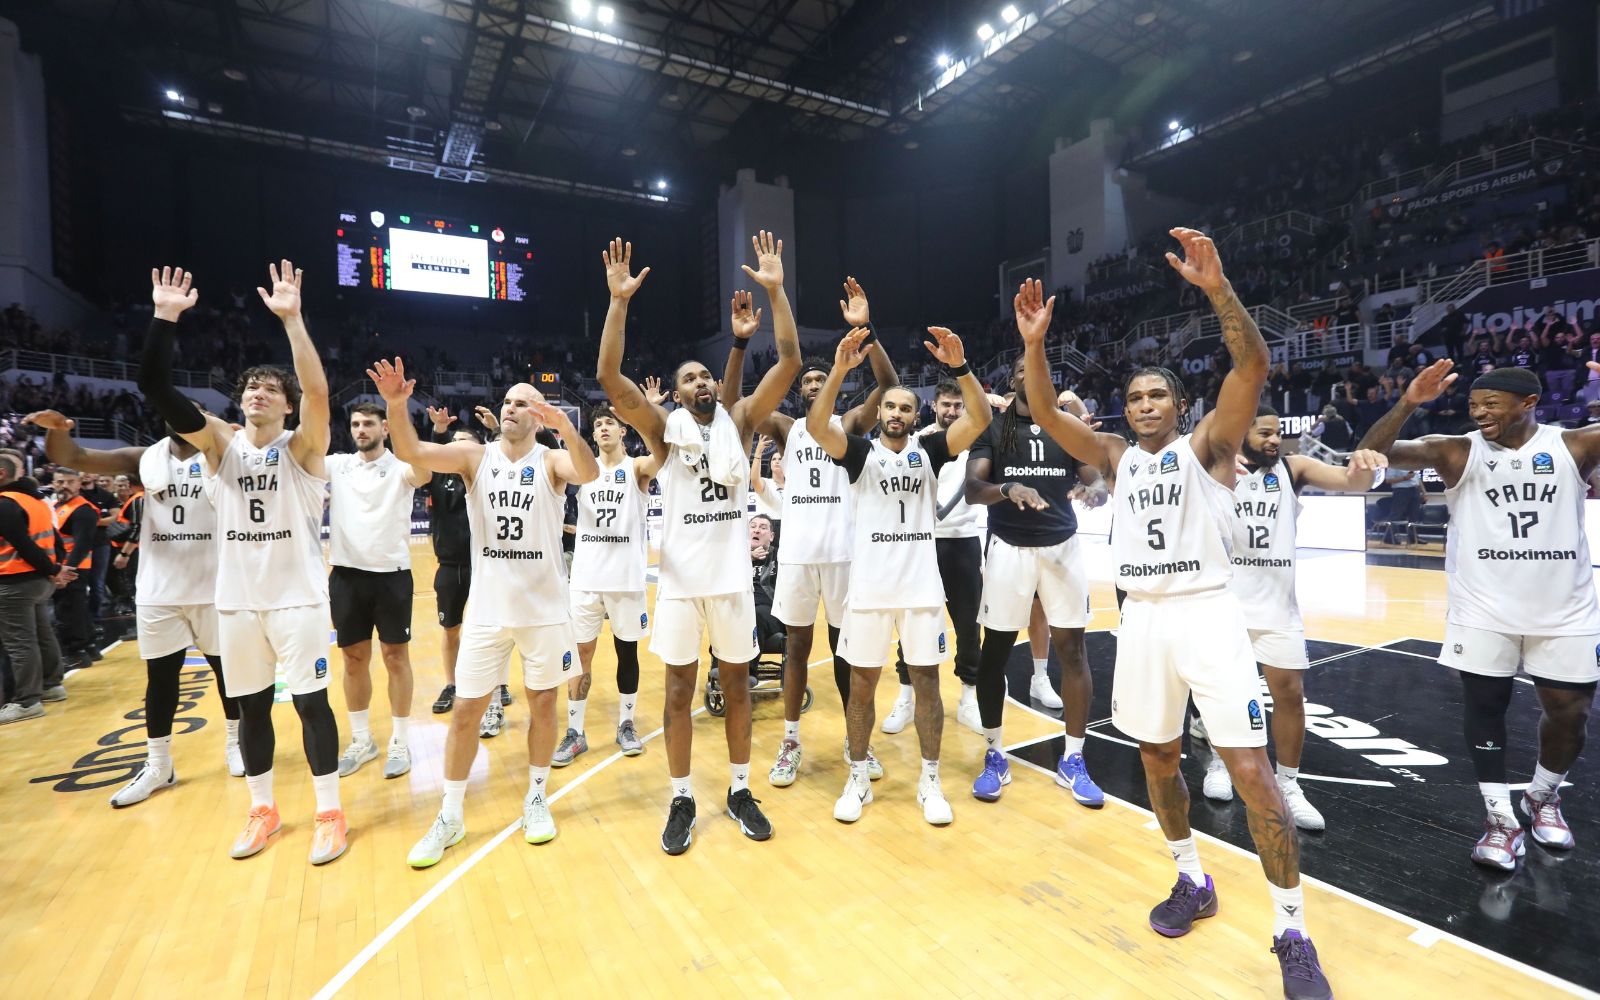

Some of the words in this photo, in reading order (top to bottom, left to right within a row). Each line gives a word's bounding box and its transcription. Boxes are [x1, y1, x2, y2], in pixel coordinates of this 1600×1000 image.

[1441, 182, 1489, 201] SPORTS
[1492, 168, 1537, 189] ARENA
[417, 264, 463, 273] LIGHTING
[1029, 439, 1044, 461] 11
[810, 468, 820, 487] 8
[1004, 466, 1066, 477] Stoiximan
[700, 477, 728, 502] 26
[880, 476, 922, 495] PAOK
[1485, 483, 1557, 507] PAOK
[488, 490, 534, 511] PAOK
[590, 490, 624, 504] PAOK
[792, 495, 841, 504] Stoiximan
[1128, 484, 1182, 514] PAOK
[173, 505, 184, 524] 0
[250, 499, 265, 522] 6
[596, 509, 616, 527] 77
[899, 500, 905, 523] 1
[1235, 502, 1278, 519] PAOK
[497, 516, 523, 540] 33
[1147, 518, 1165, 550] 5
[1508, 511, 1538, 538] 17
[152, 533, 211, 541] Stoiximan
[581, 534, 629, 542] Stoiximan
[872, 532, 932, 542] Stoiximan
[1247, 525, 1269, 548] 12
[1478, 549, 1576, 560] Stoiximan
[1120, 560, 1200, 577] Stoiximan
